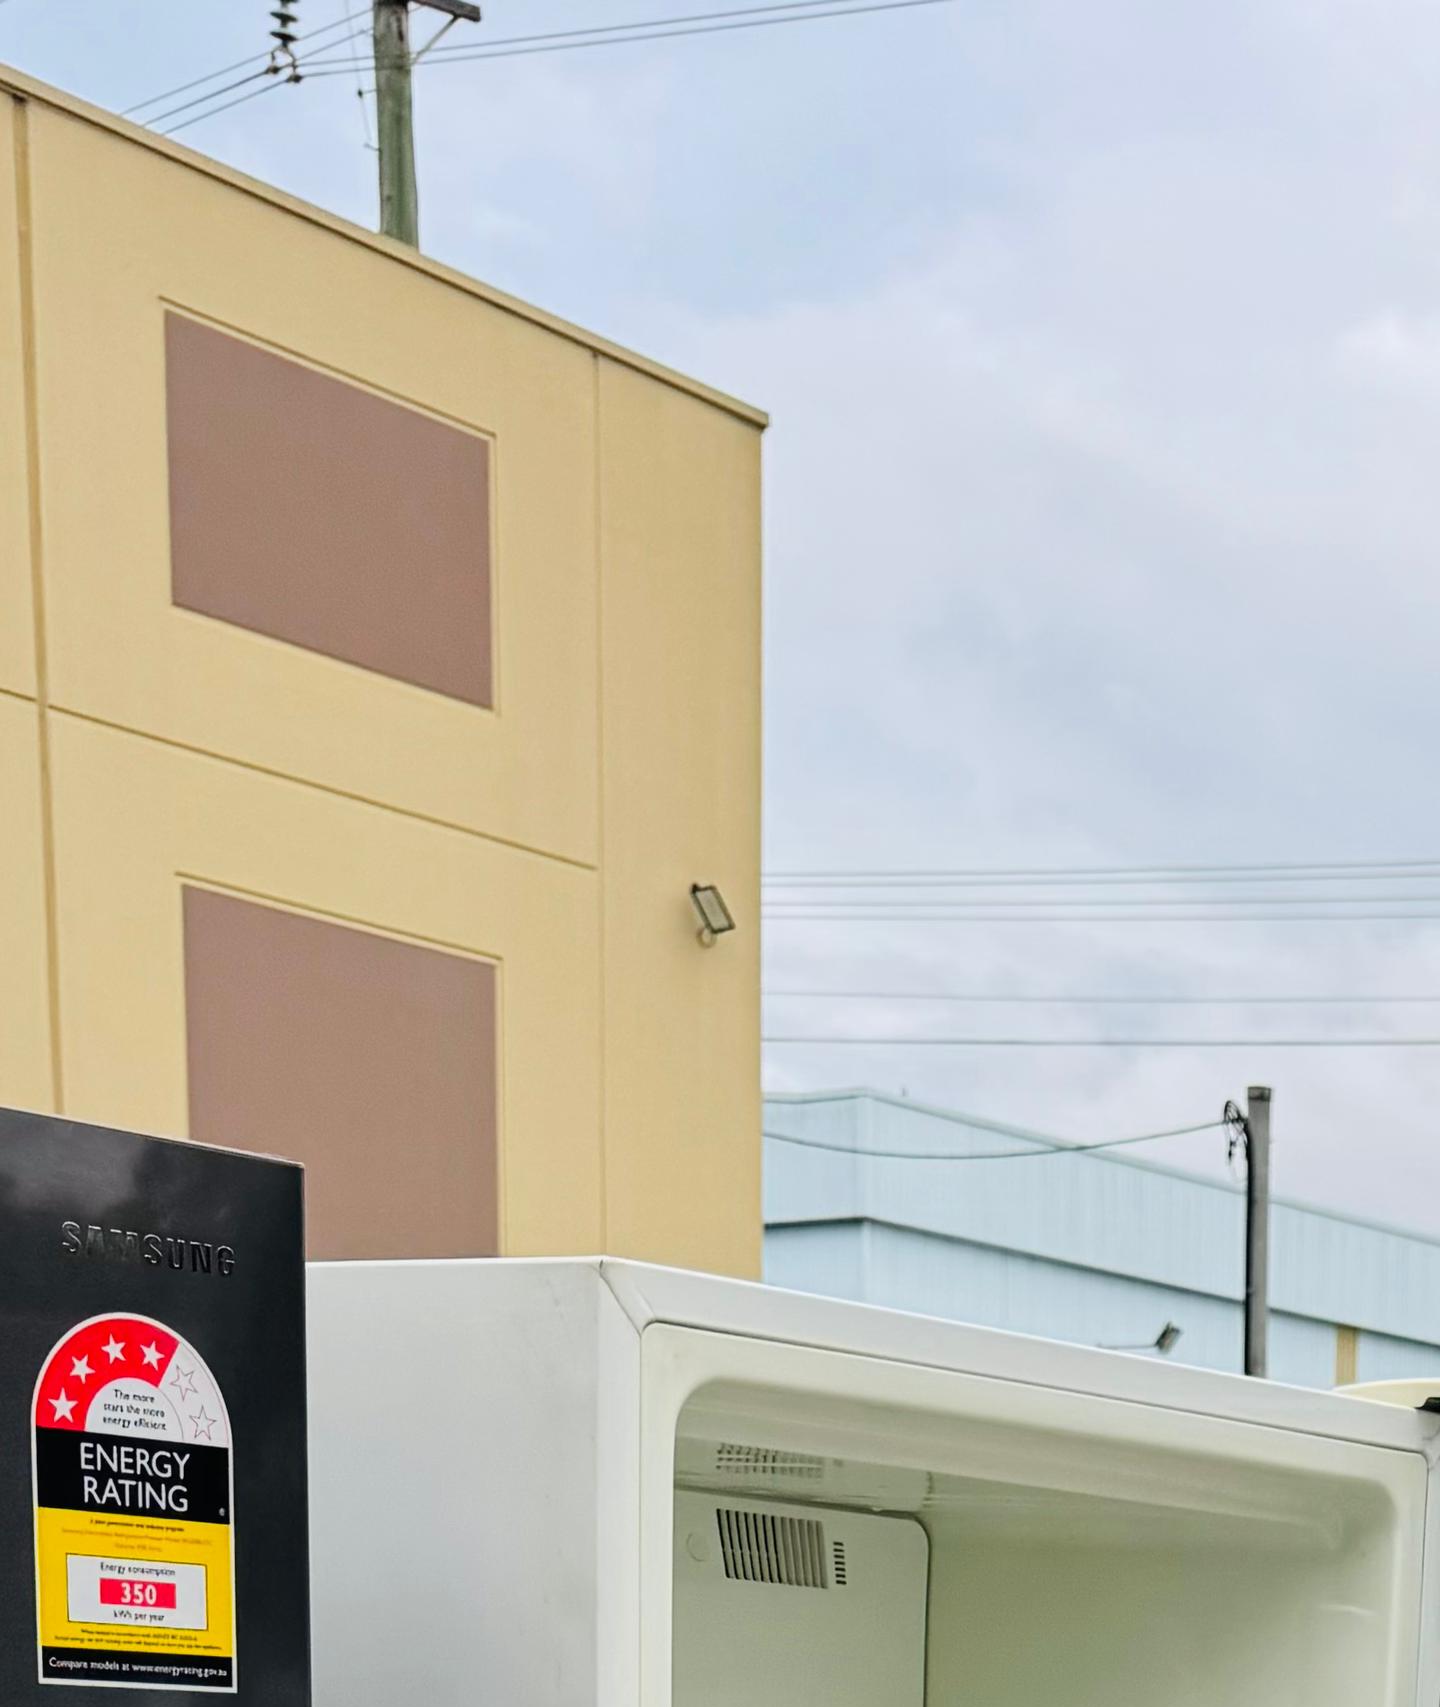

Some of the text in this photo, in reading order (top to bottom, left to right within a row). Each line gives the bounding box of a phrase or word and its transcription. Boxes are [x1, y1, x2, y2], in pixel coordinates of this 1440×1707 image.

[61, 1221, 236, 1275] SAMSUNG
[114, 1389, 155, 1403] The more
[127, 1405, 140, 1415] the
[143, 1408, 165, 1418] more
[103, 1416, 131, 1429] energy
[80, 1442, 191, 1480] ENERGY
[83, 1476, 189, 1512] RATING
[100, 1561, 126, 1575] Energy
[121, 1582, 157, 1605] 350
[135, 1612, 147, 1622] per
[149, 1612, 165, 1622] year
[49, 1656, 88, 1670] Compare
[90, 1661, 120, 1671] models
[122, 1663, 130, 1672] at
